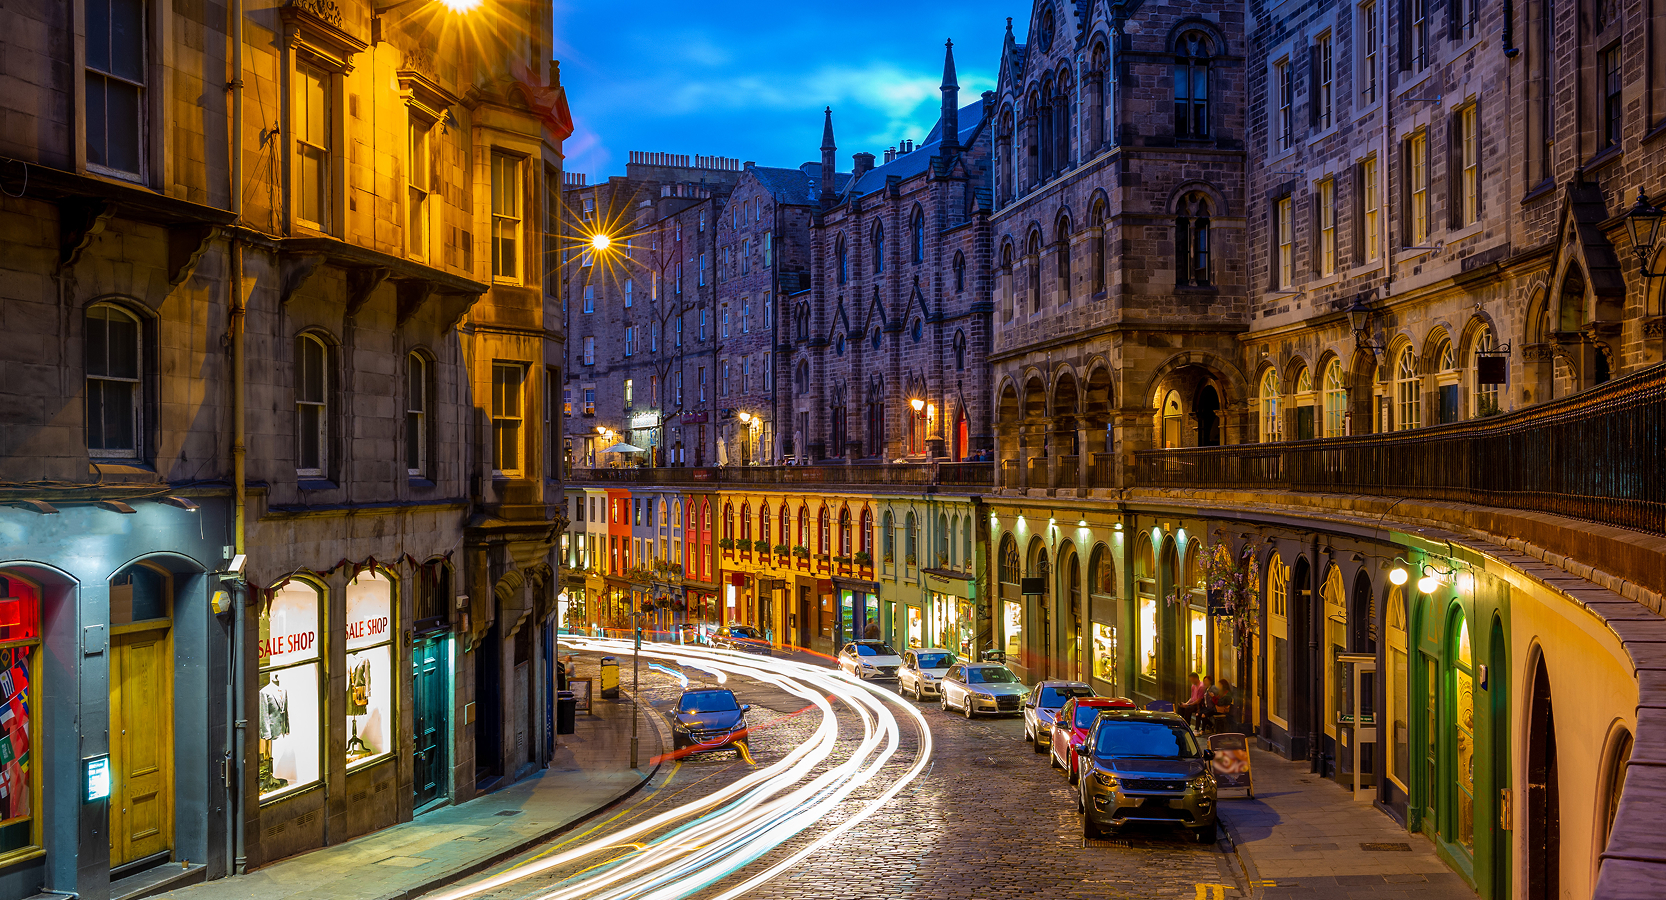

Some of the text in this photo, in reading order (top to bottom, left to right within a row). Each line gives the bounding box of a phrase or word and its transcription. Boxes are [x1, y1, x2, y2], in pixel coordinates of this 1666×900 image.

[346, 616, 388, 640] SALE SHOP
[259, 631, 315, 658] SALE SHOP
